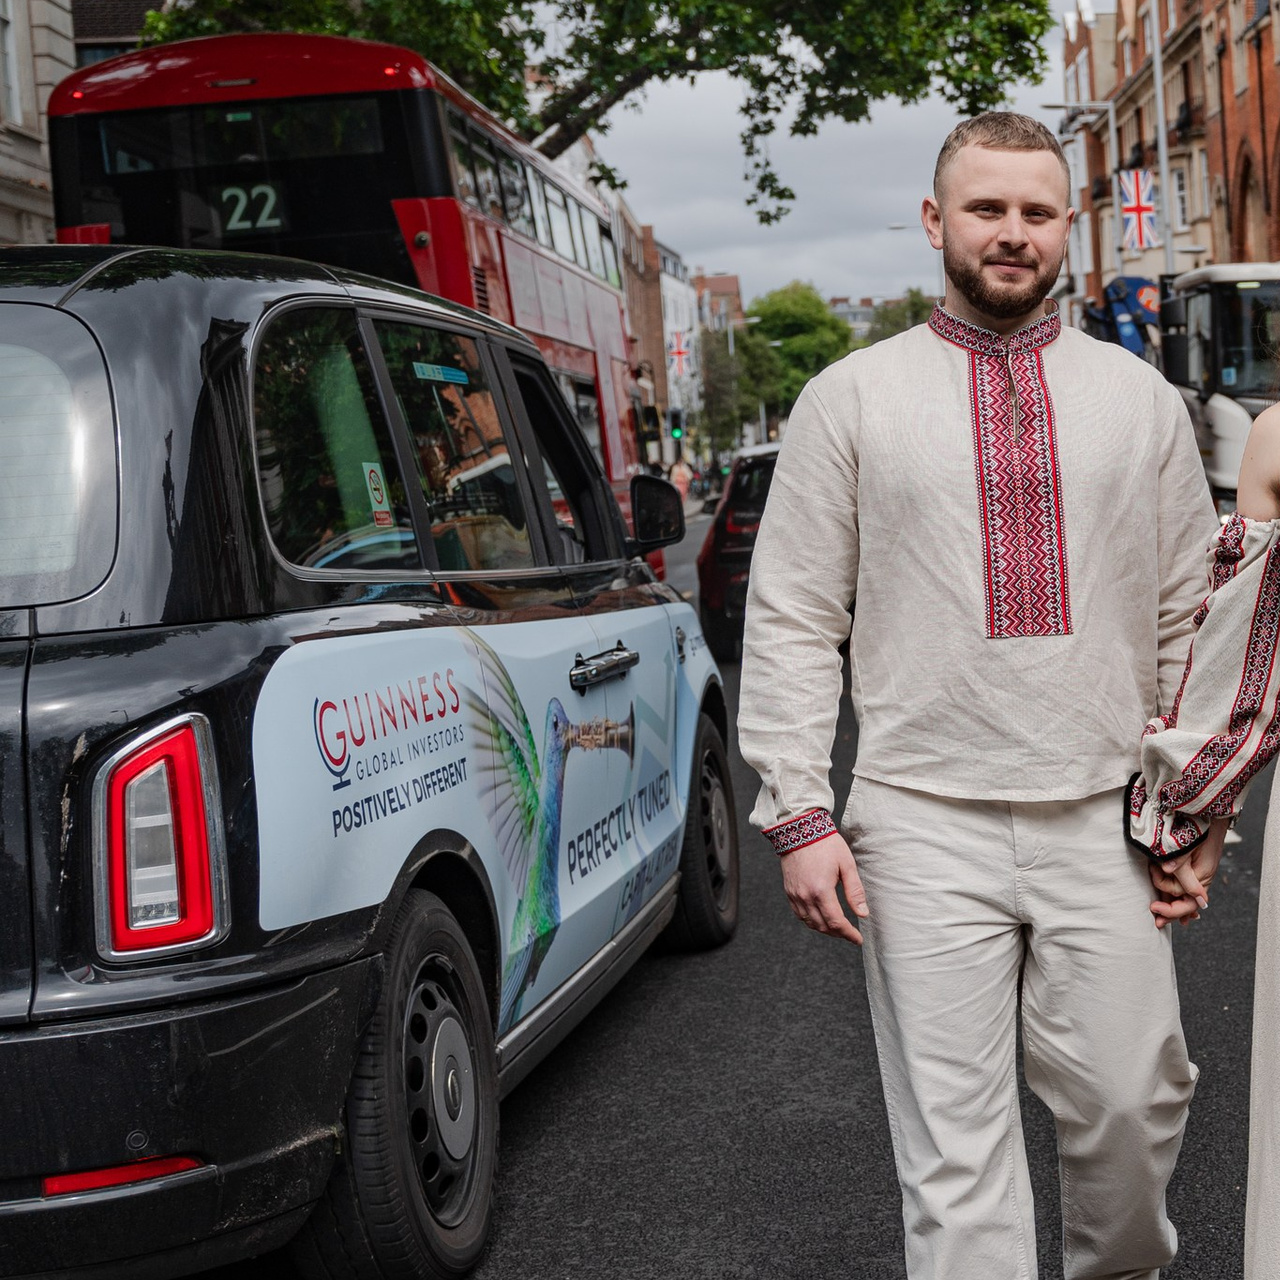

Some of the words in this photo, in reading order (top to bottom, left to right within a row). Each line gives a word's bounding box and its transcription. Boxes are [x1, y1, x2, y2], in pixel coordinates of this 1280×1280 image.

[221, 184, 281, 230] 22
[318, 668, 460, 767] GUINNESS
[356, 747, 404, 780] GLOBAL
[407, 723, 465, 761] INVESTORS
[332, 781, 412, 837] POSITIVELY
[412, 757, 468, 803] DIFFERENT
[567, 794, 637, 885] PERFECTLY
[638, 769, 671, 827] TUNED
